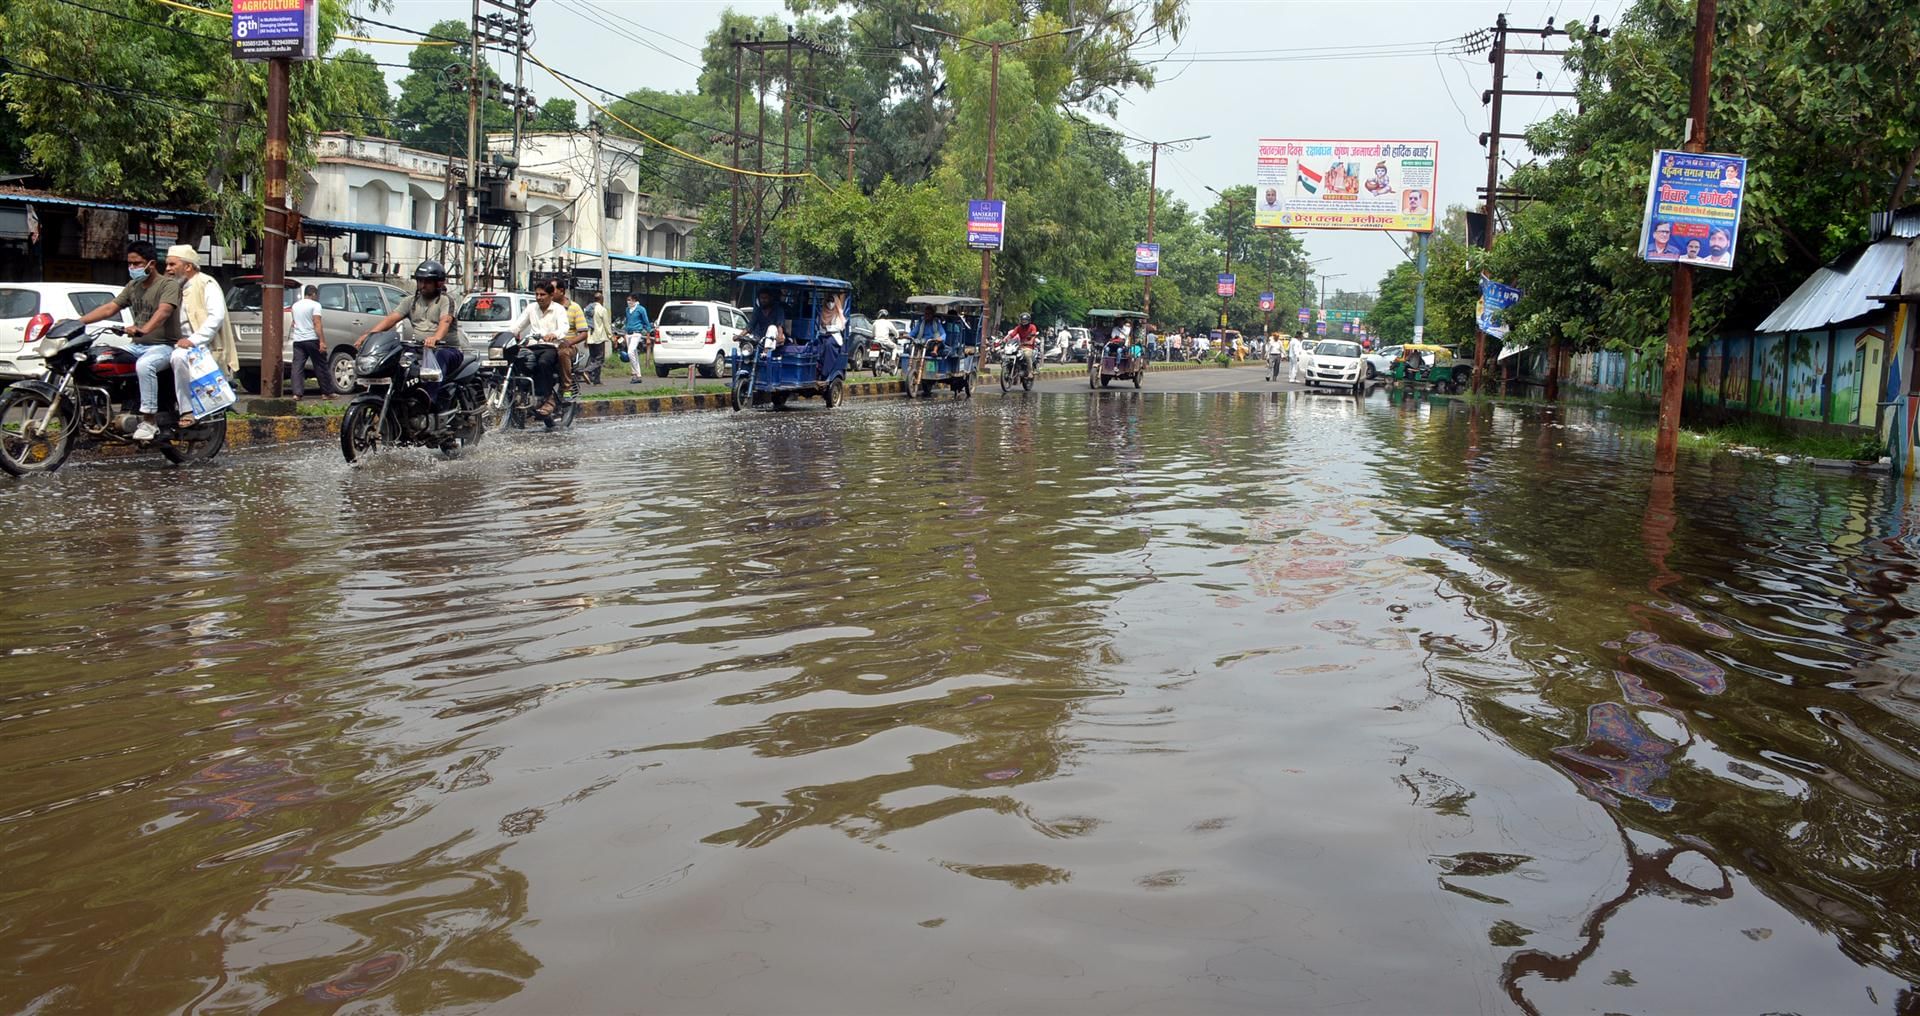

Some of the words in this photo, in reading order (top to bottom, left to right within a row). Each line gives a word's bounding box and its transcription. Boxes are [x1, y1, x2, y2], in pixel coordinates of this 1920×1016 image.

[242, 0, 300, 11] AGRICULTURE
[237, 20, 258, 37] 8th
[1382, 144, 1391, 157] की
[1392, 144, 1411, 158] हार्दिक
[1294, 214, 1312, 223] प्रेस
[406, 377, 420, 388] 150
